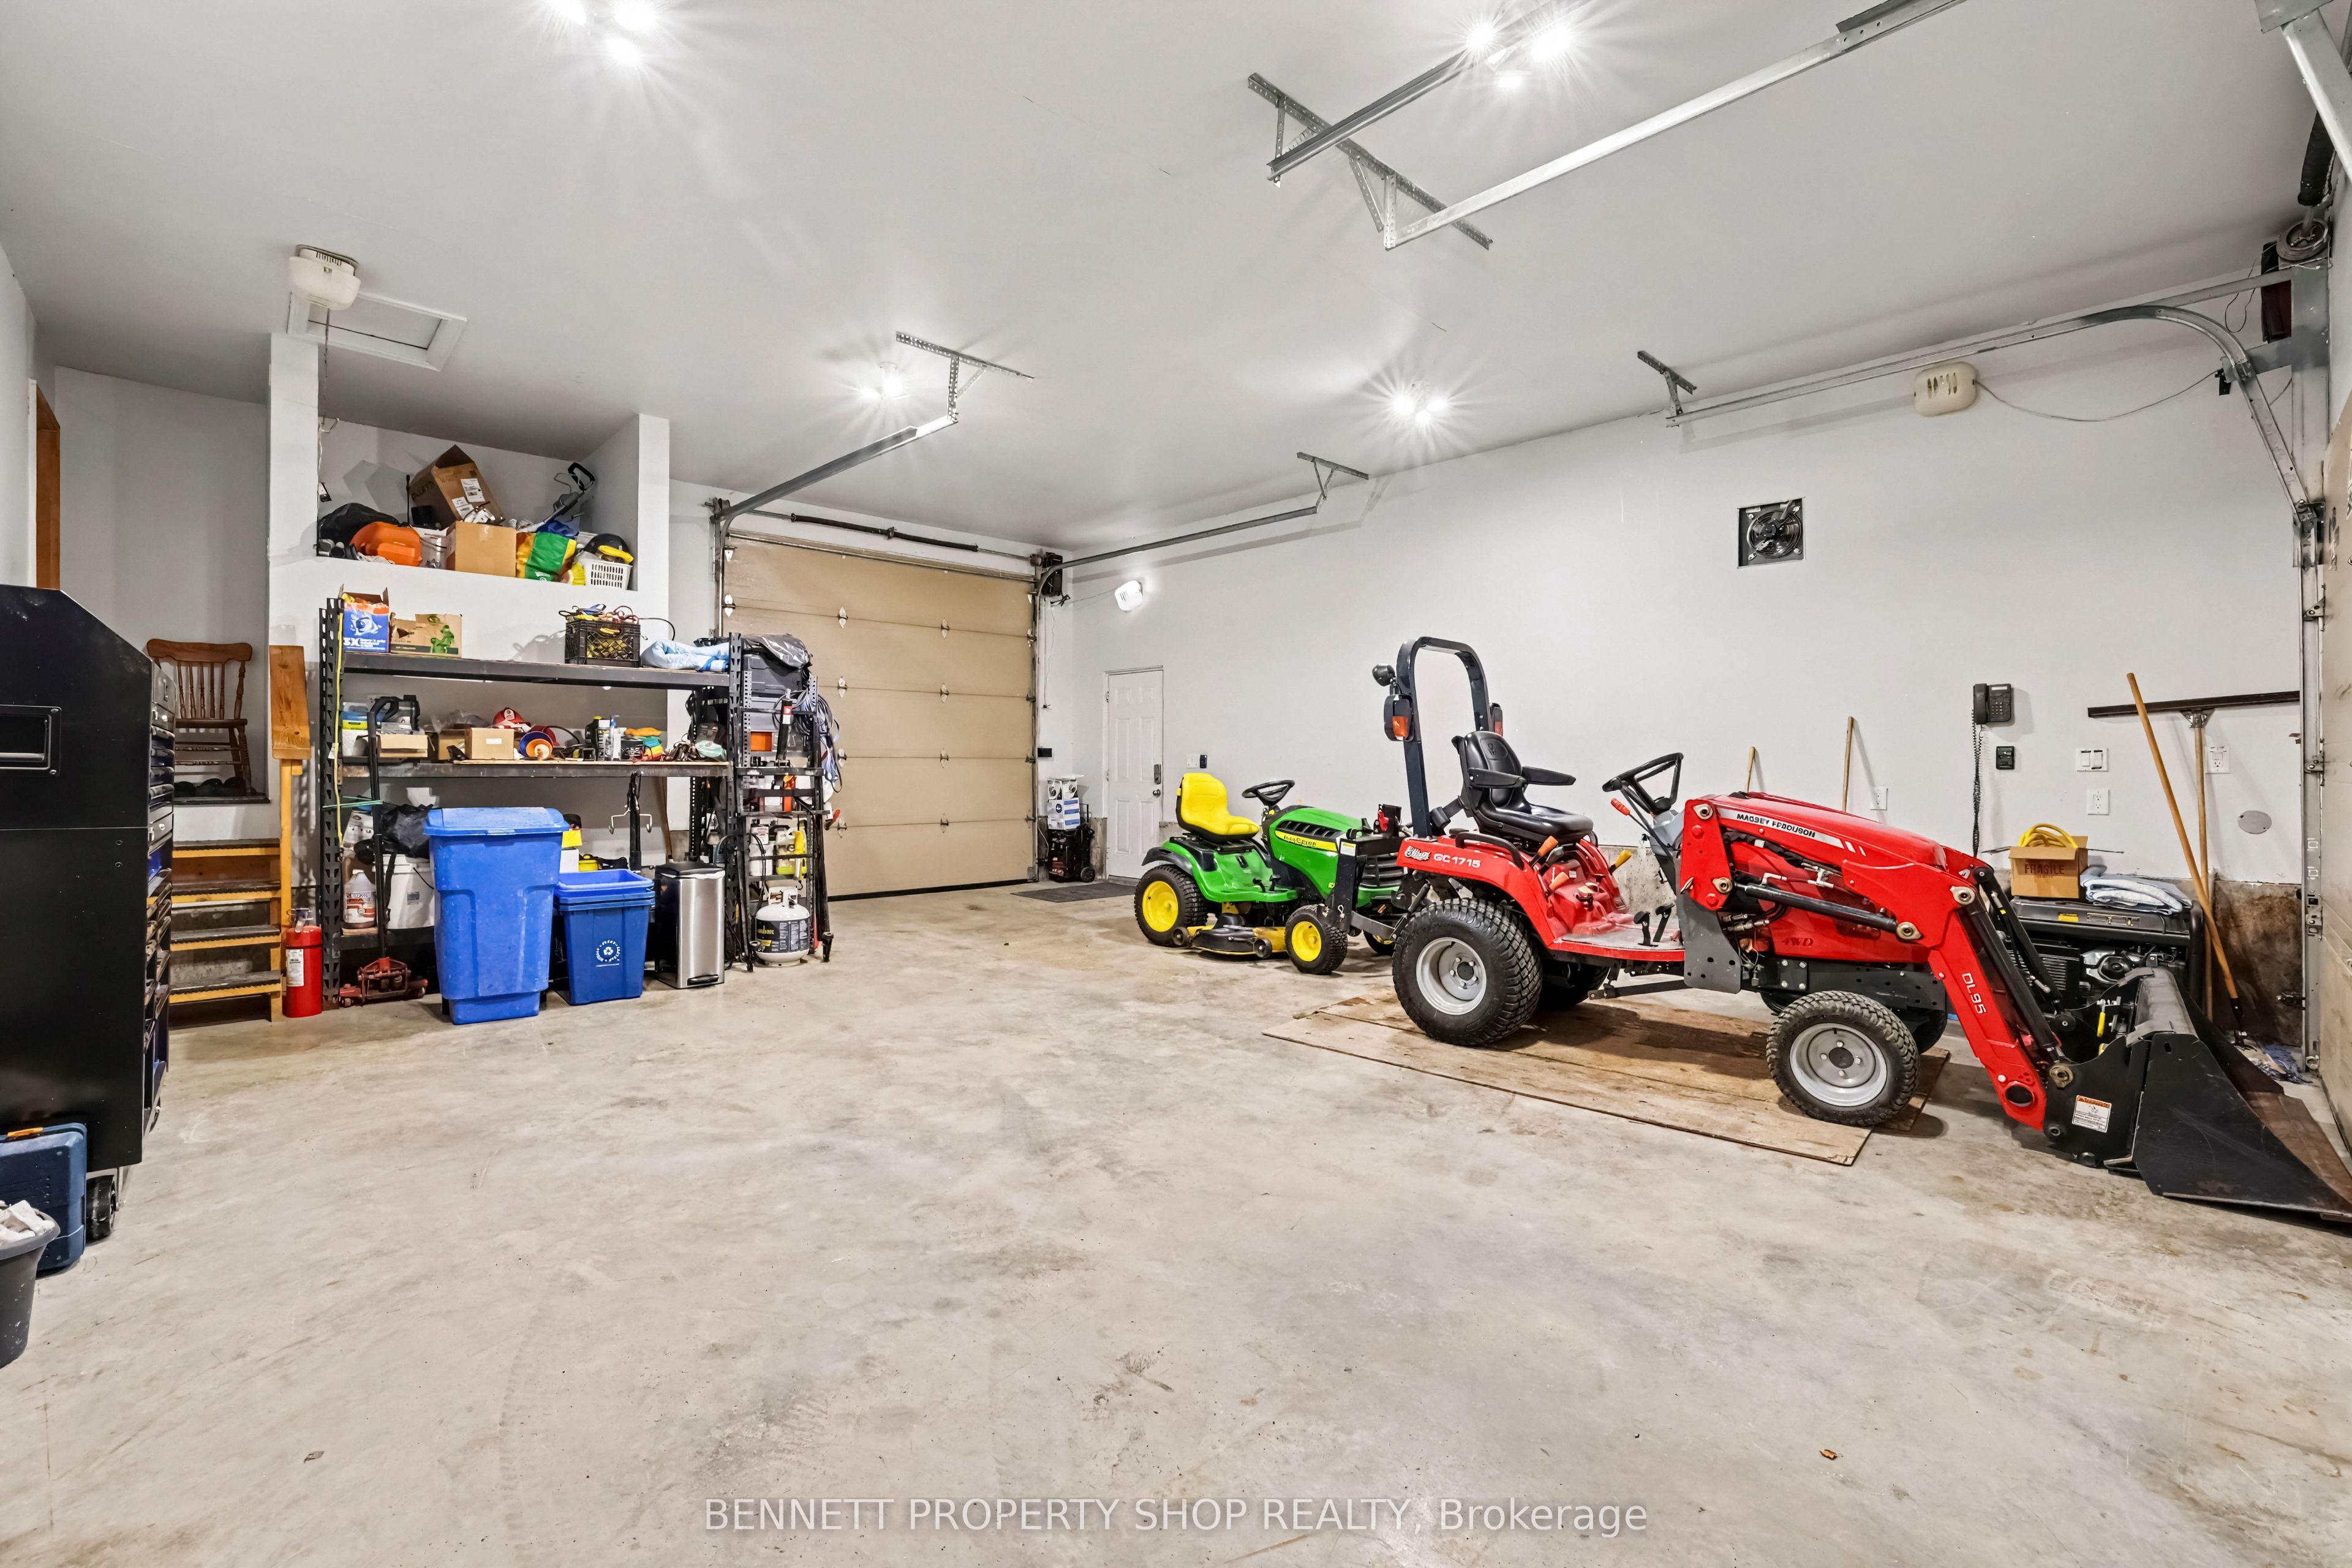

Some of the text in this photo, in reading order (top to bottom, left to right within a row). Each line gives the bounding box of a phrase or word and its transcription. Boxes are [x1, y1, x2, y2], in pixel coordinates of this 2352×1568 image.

[2024, 864, 2065, 875] FRAGILE
[1782, 937, 1814, 946] 4WD
[1961, 972, 1987, 1014] DL95
